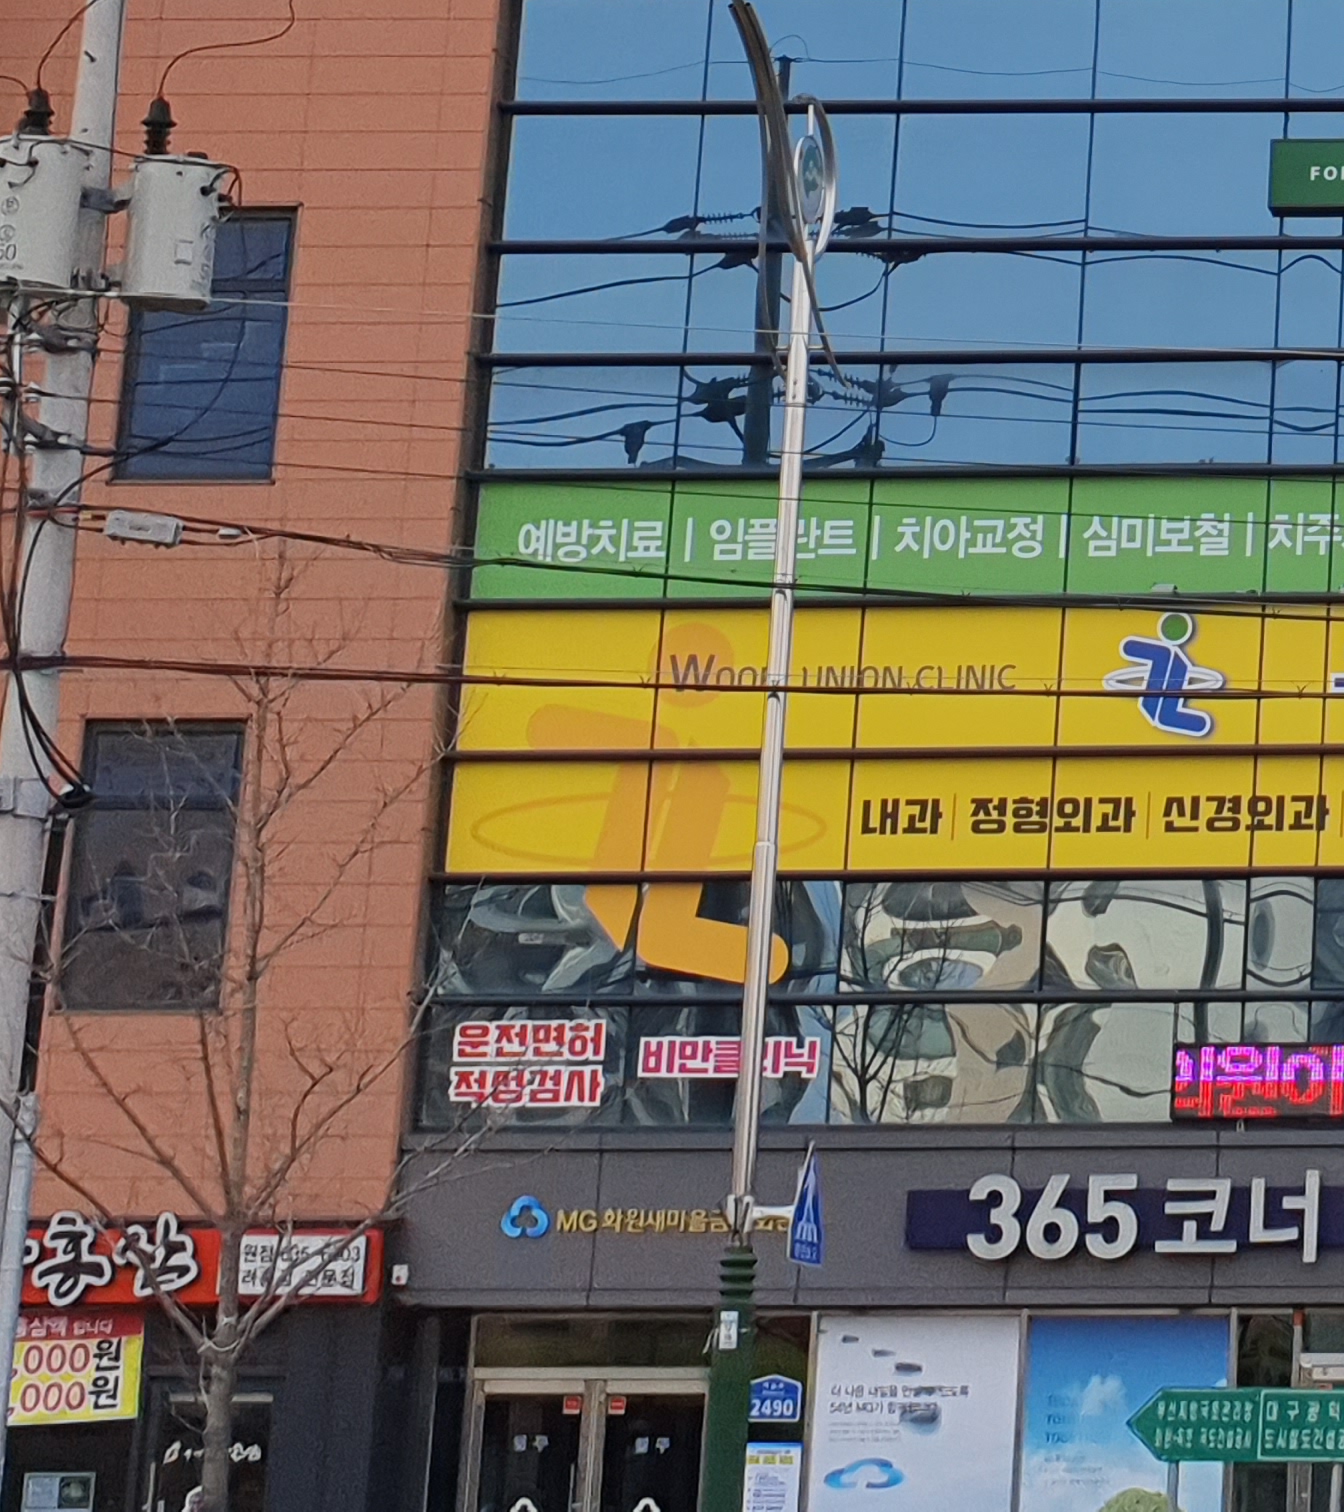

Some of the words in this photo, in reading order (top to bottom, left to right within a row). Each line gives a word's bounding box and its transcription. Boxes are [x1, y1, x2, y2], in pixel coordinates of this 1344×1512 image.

[518, 518, 666, 562] 예방치료
[893, 514, 1045, 560] 치아교정
[1082, 513, 1233, 558] 심미보철
[915, 662, 1018, 692] CLINIC
[859, 796, 943, 836] 내과
[968, 796, 1136, 835] 정형외과
[1161, 792, 1330, 834] 신경외과
[456, 1021, 606, 1062] 운전면허
[450, 1066, 602, 1108] 적성검사
[750, 1399, 793, 1416] 2490
